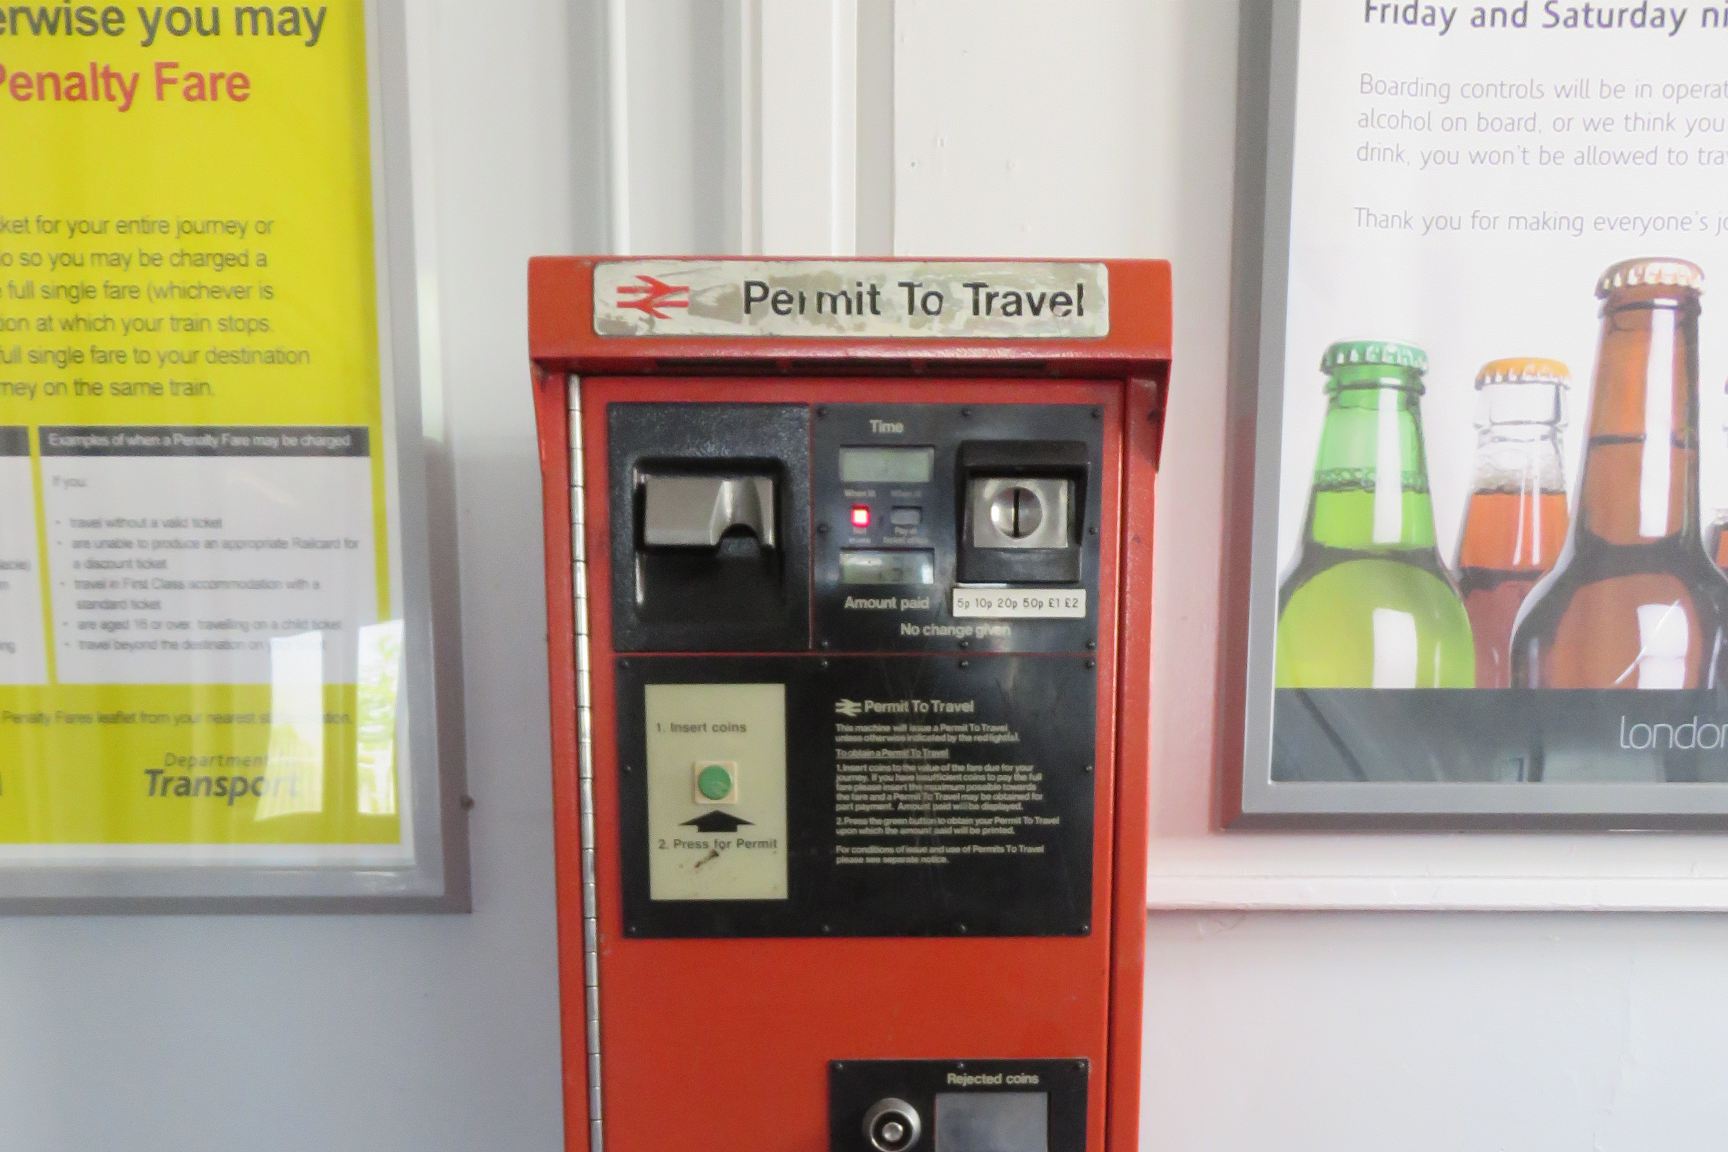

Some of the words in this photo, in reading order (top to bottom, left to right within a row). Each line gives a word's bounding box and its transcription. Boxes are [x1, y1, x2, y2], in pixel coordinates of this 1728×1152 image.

[0, 0, 125, 36] rwise
[137, 5, 221, 48] you
[234, 5, 327, 47] may
[1363, 0, 1457, 36] Friday
[1470, 0, 1528, 28] and
[1542, 0, 1687, 37] Saturday
[0, 62, 140, 112] enalty
[154, 62, 251, 102] Fare
[1360, 73, 1450, 104] Boarding
[1460, 79, 1544, 100] controls
[1554, 78, 1590, 99] will
[1599, 79, 1625, 99] be
[1634, 80, 1652, 99] in
[1357, 109, 1432, 131] alcohol
[1441, 115, 1467, 132] on
[1552, 116, 1575, 132] or
[1582, 116, 1615, 132] we
[1624, 112, 1676, 132] think
[1684, 117, 1725, 137] you
[1419, 148, 1459, 170] you
[1539, 146, 1565, 165] be
[1573, 145, 1658, 165] allowed
[1667, 147, 1688, 165] to
[1698, 147, 1728, 165] tra
[36, 214, 62, 234] for
[66, 219, 110, 239] your
[116, 214, 170, 234] entire
[175, 216, 249, 240] journey
[255, 219, 275, 234] or
[1354, 207, 1413, 231] Thank
[1422, 213, 1462, 236] you
[1471, 209, 1500, 231] for
[1507, 210, 1584, 237] making
[19, 252, 43, 267] so
[48, 253, 84, 272] you
[90, 252, 133, 272] may
[139, 248, 163, 267] be
[169, 247, 249, 272] charged
[256, 252, 269, 267] a
[8, 280, 35, 300] full
[40, 280, 97, 304] single
[103, 280, 140, 300] fare
[147, 279, 253, 304] (whichever
[259, 280, 275, 300] is
[742, 279, 881, 316] Permit
[897, 281, 943, 316] To
[963, 281, 1085, 318] Travel
[36, 315, 55, 332] at
[59, 312, 116, 332] which
[121, 317, 163, 337] your
[170, 314, 212, 332] train
[28, 345, 84, 369] single
[90, 344, 128, 364] fare
[133, 348, 151, 364] to
[156, 349, 200, 369] your
[205, 345, 310, 365] destination
[43, 382, 68, 396] on
[73, 378, 104, 396] the
[110, 381, 163, 396] same
[869, 419, 904, 433] Time
[49, 432, 110, 449] Examples
[112, 432, 126, 447] of
[127, 433, 161, 447] when
[163, 435, 173, 447] a
[173, 432, 219, 449] Penalty
[221, 432, 251, 447] Fare
[252, 435, 280, 449] may
[281, 433, 299, 447] be
[300, 433, 351, 450] charged
[844, 596, 897, 610] Amount
[901, 596, 930, 612] paid
[957, 597, 970, 609] 5p
[975, 598, 993, 610] 10p
[997, 597, 1018, 610] 20p
[1023, 597, 1044, 610] 50p
[1048, 598, 1060, 609] £1
[1065, 598, 1080, 609] £2
[900, 622, 920, 636] No
[922, 622, 973, 638] change
[975, 622, 1012, 639] given
[864, 700, 909, 713] Permit
[912, 700, 929, 713] To
[931, 699, 974, 713] Travel
[670, 722, 707, 733] Insert
[712, 722, 748, 733] coins
[673, 838, 709, 849] Press
[713, 838, 732, 849] for
[736, 838, 777, 849] Permit
[947, 1072, 1002, 1087] Rejected
[1006, 1072, 1039, 1085] coins
